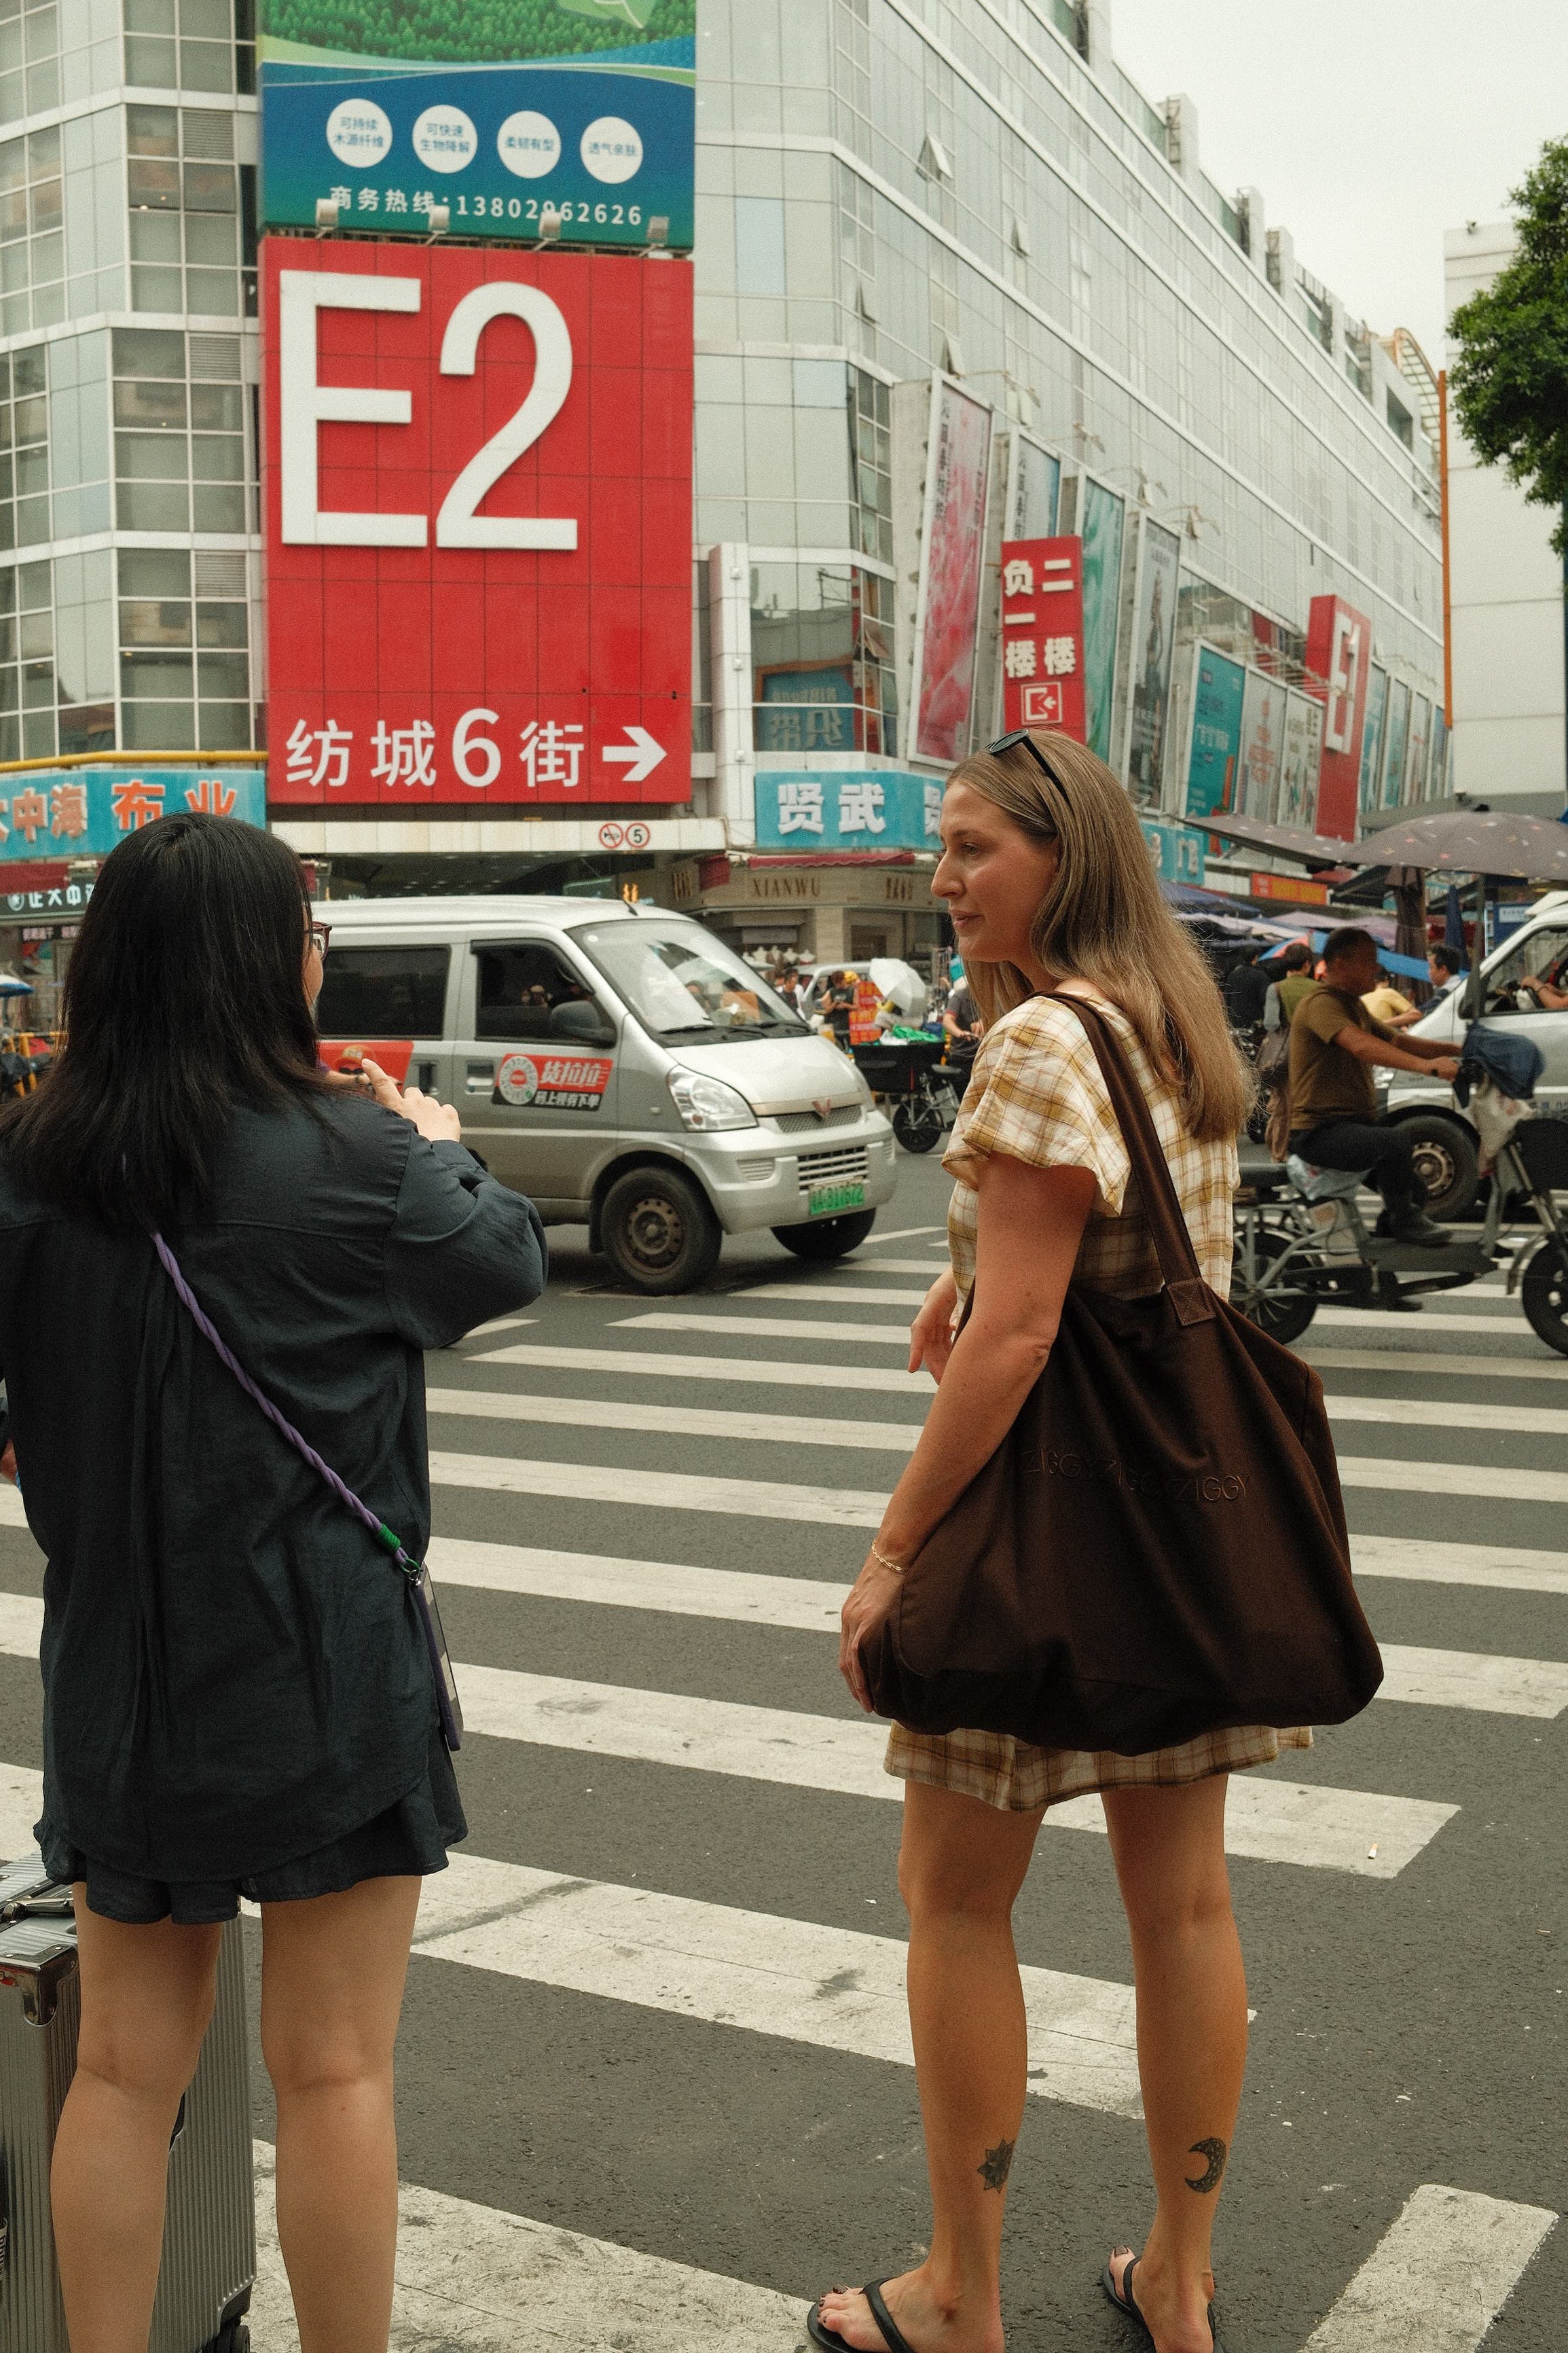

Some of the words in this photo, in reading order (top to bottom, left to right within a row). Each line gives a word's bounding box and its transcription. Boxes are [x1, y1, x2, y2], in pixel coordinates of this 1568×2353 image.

[280, 270, 577, 550] E2
[285, 708, 585, 789] 纺城6街
[633, 828, 643, 843] 5
[752, 877, 820, 897] XIANWU
[539, 1060, 602, 1088] 货拉拉
